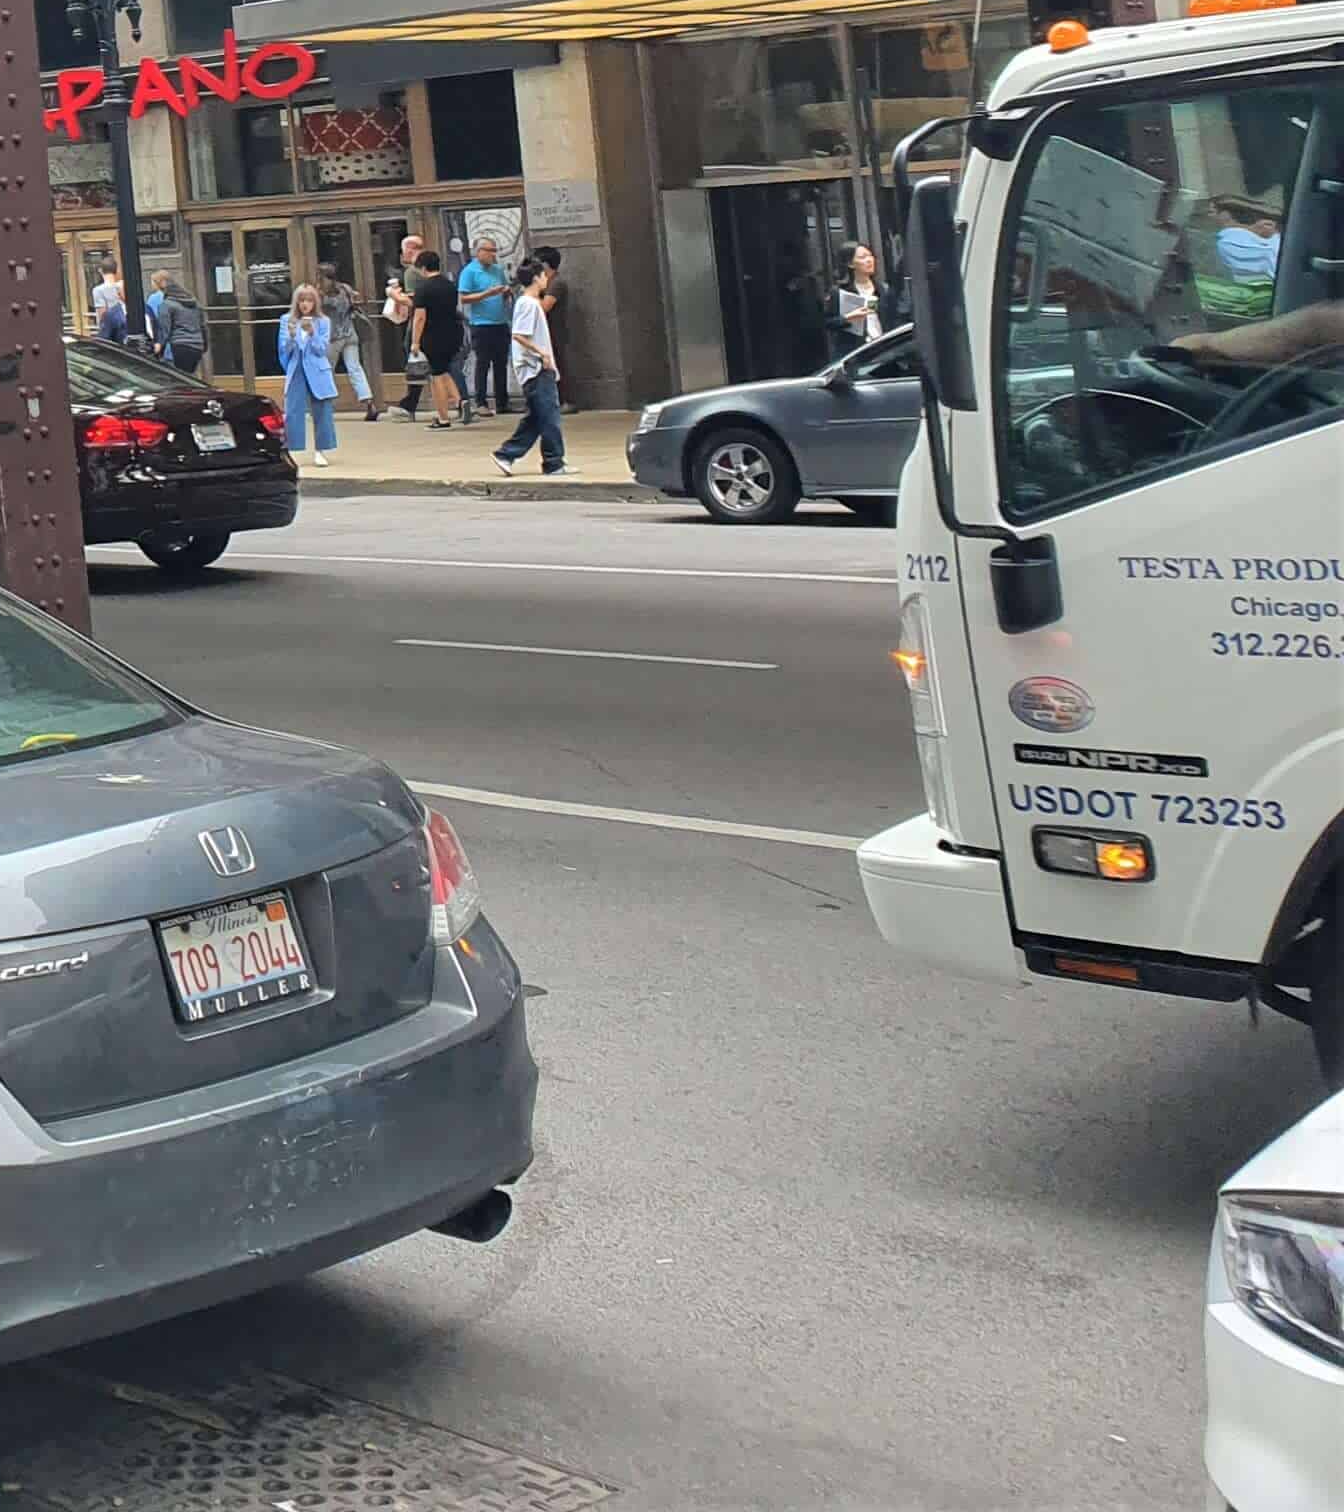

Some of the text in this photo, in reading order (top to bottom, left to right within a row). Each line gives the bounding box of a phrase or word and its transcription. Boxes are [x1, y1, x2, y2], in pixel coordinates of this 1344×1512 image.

[42, 28, 316, 141] PANO
[906, 553, 950, 582] 2112
[1118, 556, 1224, 579] TESTA
[1211, 632, 1344, 658] 312.226.
[1008, 784, 1286, 830] USDOT 723253
[205, 913, 259, 935] Illinois
[170, 923, 301, 996] 709 2044
[186, 973, 311, 1021] MULLER
